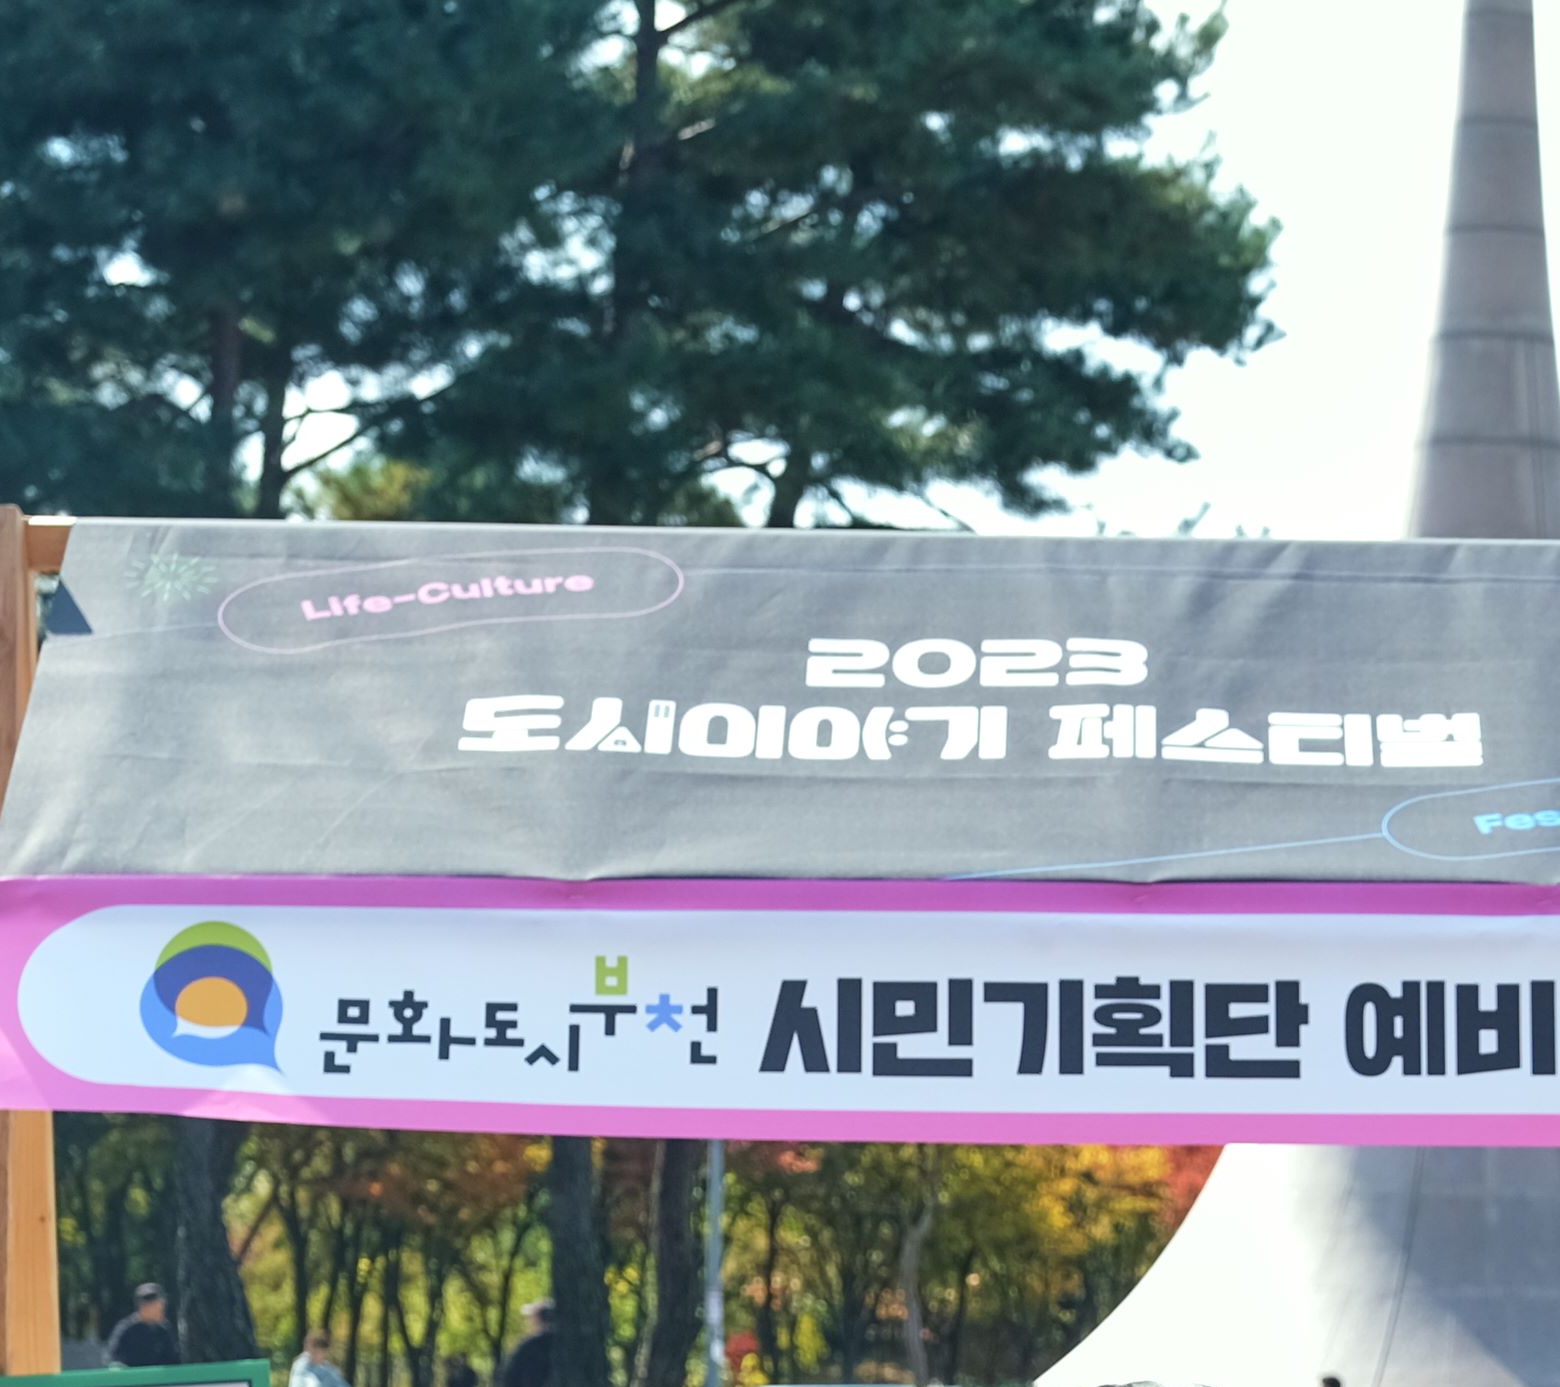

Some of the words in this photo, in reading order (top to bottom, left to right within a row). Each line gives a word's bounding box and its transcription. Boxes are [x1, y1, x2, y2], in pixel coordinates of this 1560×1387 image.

[300, 569, 595, 622] Life-Culture
[805, 637, 1150, 689] 2023
[457, 694, 1009, 761] 도시이야기
[1047, 702, 1485, 769] 페스티벌
[758, 976, 1310, 1079] 시민기획단
